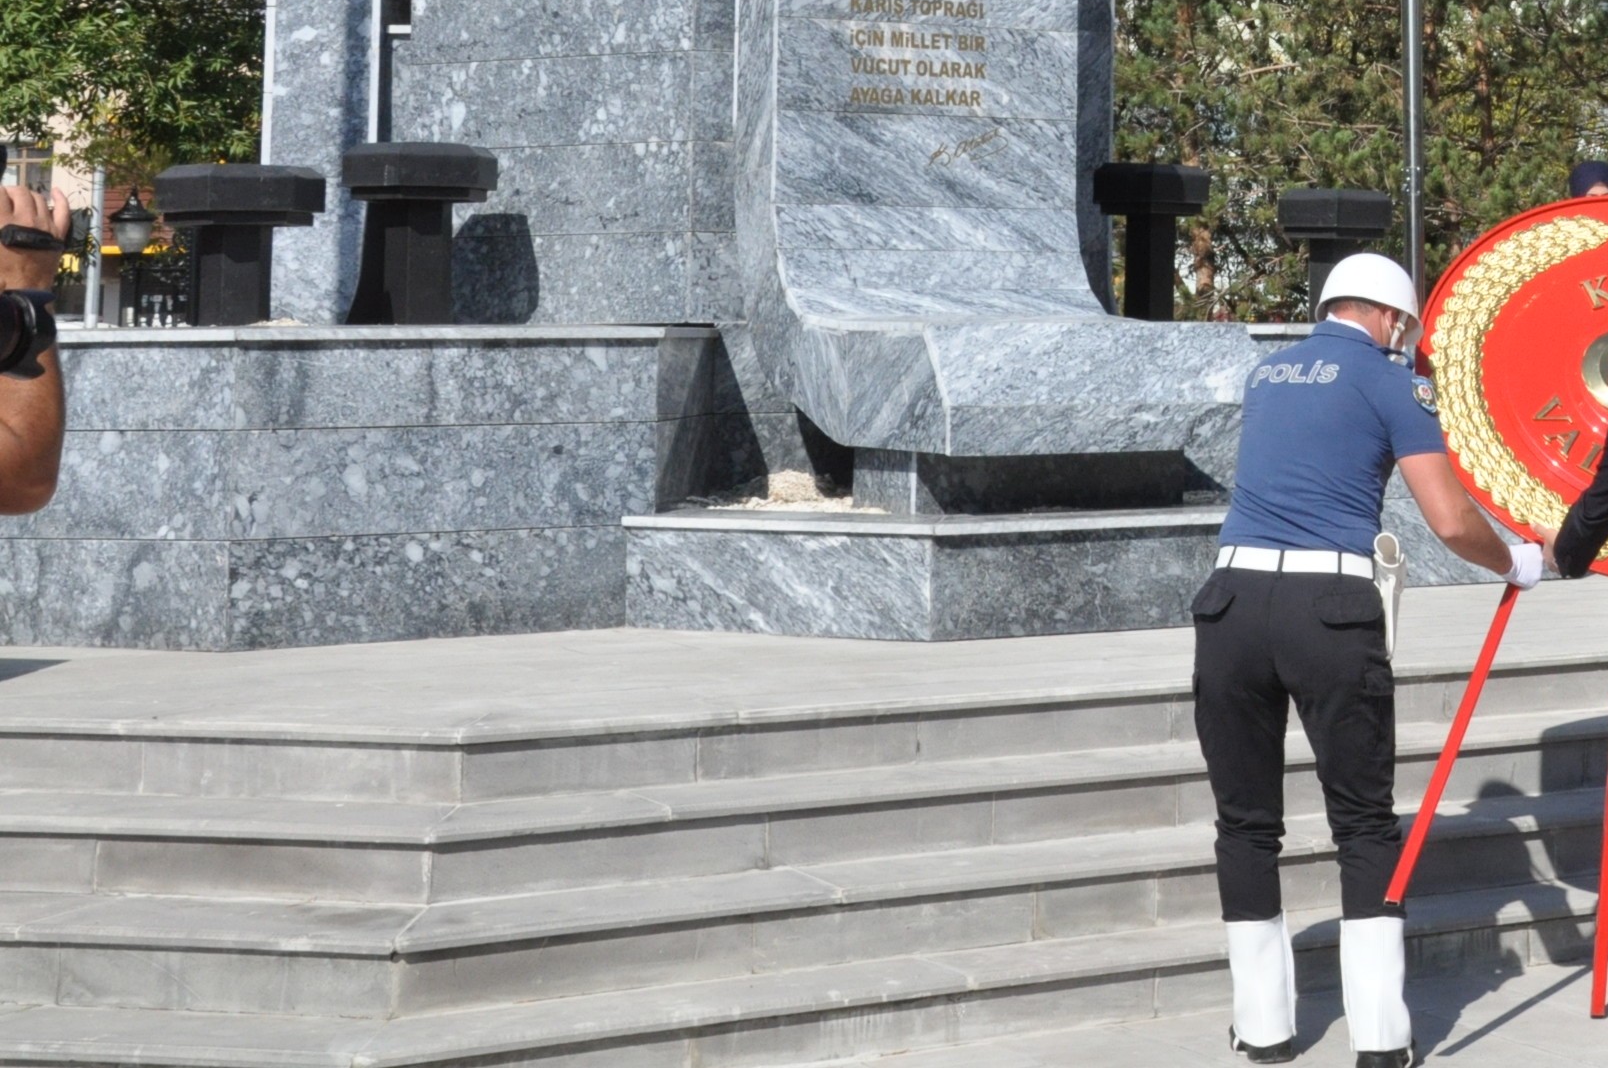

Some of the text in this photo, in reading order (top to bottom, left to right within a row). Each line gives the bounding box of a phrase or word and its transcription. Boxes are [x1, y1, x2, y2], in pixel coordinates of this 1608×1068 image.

[850, 53, 987, 79] VÜCUT OLARAK
[849, 84, 981, 107] AYAĞA KALKAR
[1251, 359, 1340, 389] POLİS
